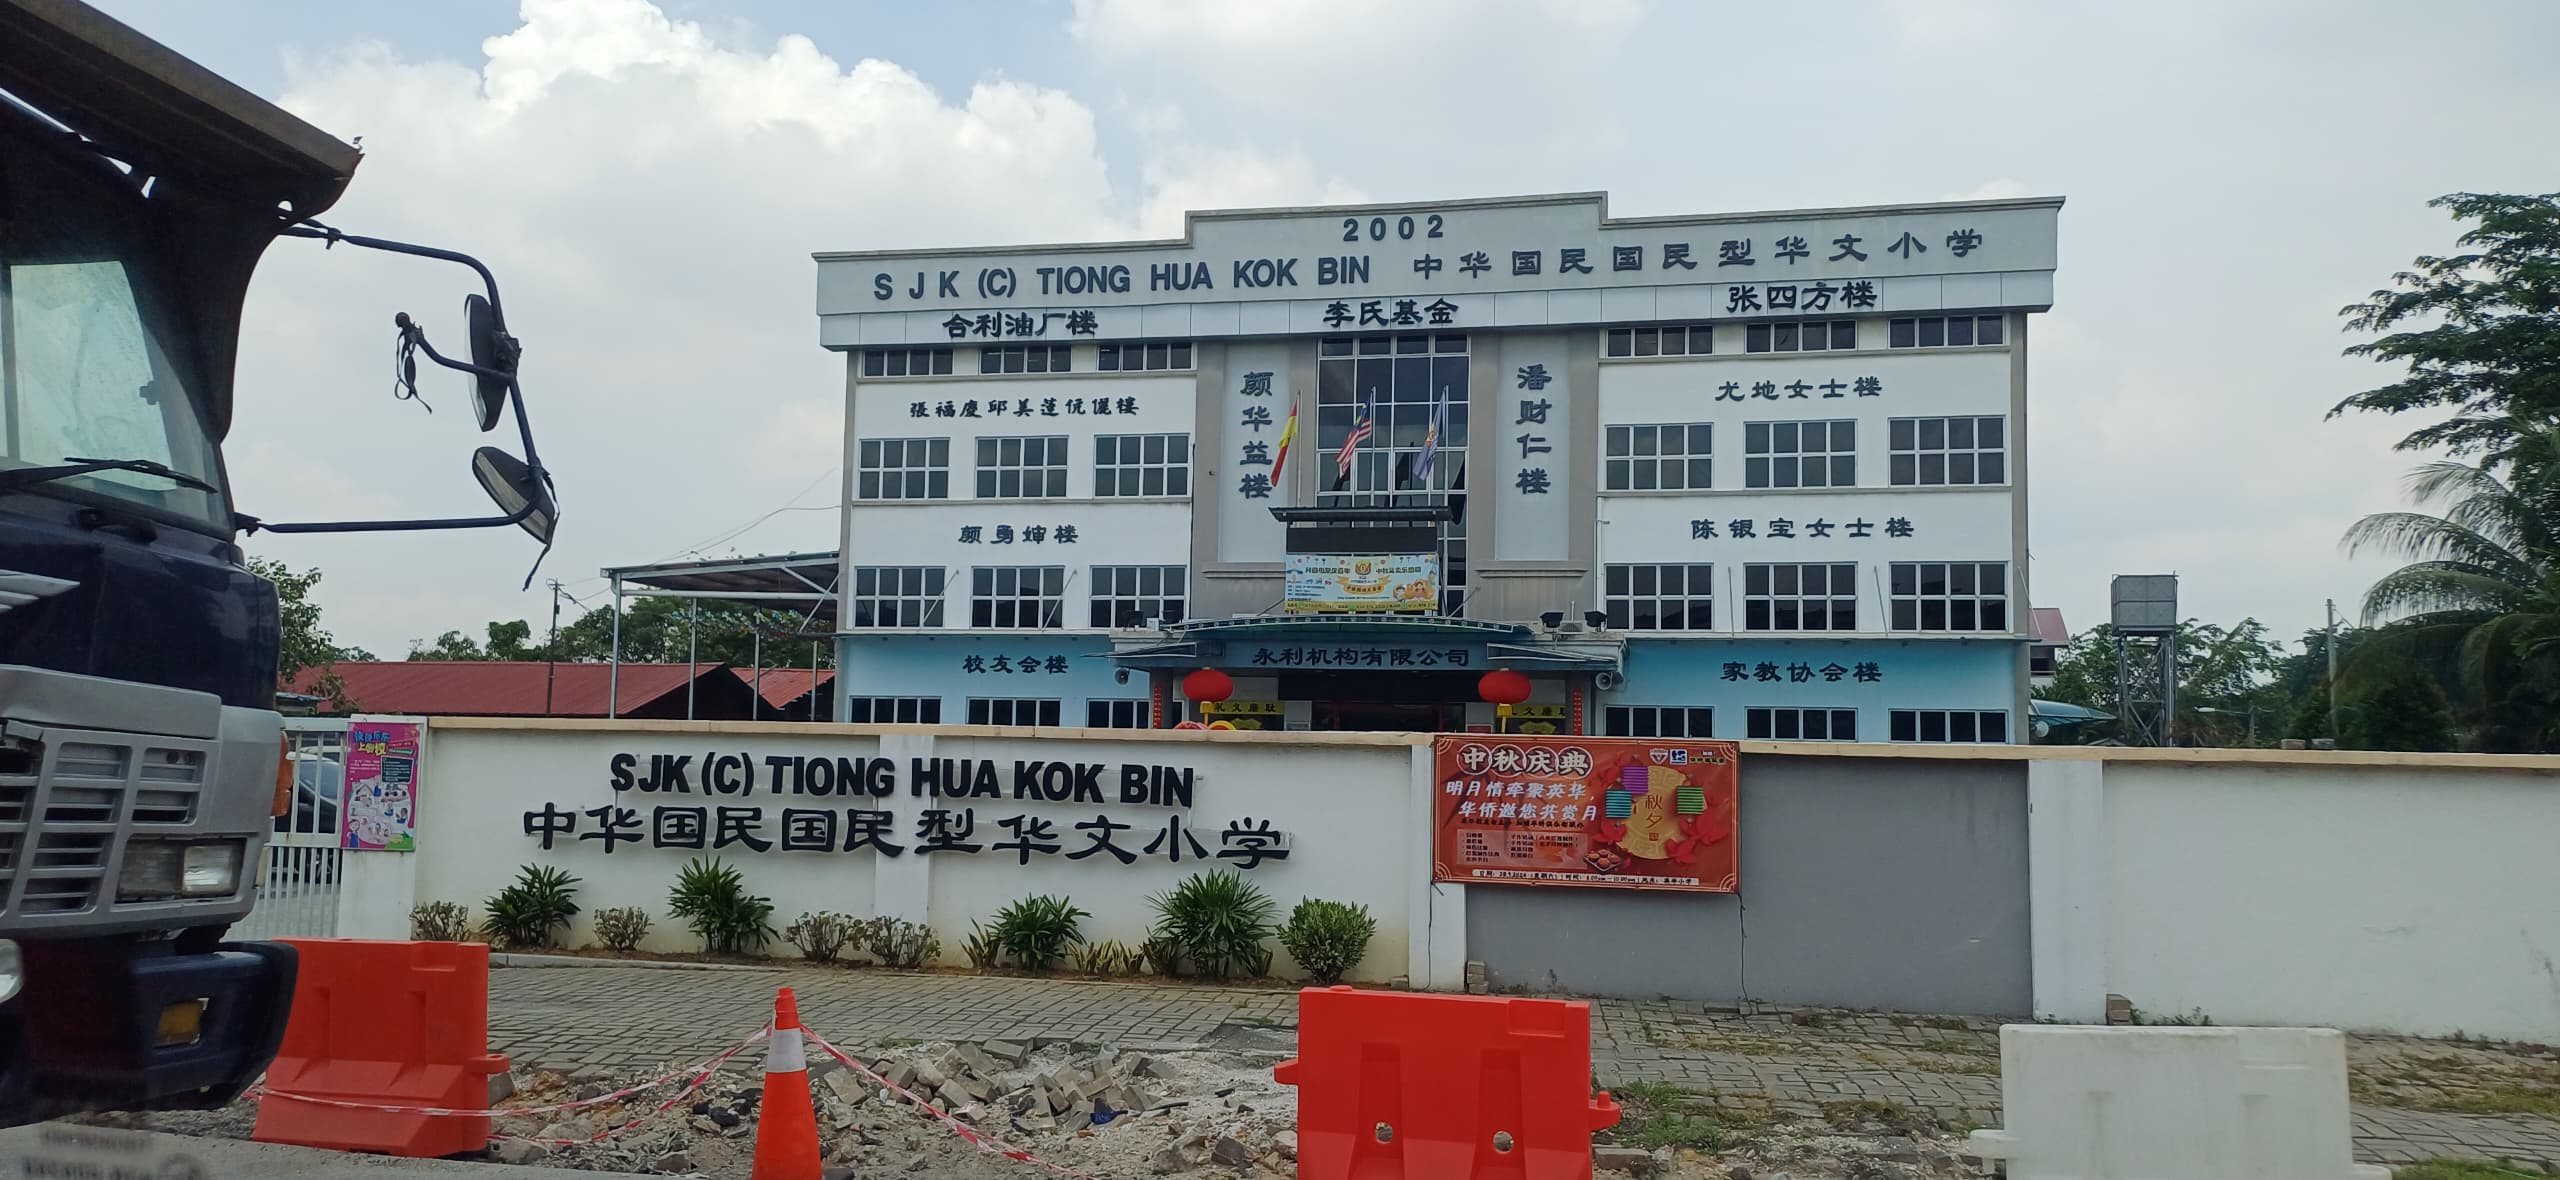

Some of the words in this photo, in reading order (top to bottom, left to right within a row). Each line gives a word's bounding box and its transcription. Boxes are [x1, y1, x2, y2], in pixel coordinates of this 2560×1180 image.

[977, 267, 1017, 300] (C)
[1035, 264, 1131, 295] TIONG
[1150, 261, 1214, 292] HUA
[1233, 258, 1299, 289] KOK
[1317, 255, 1371, 286] BIN
[1727, 280, 1878, 314] 张四方楼
[942, 310, 1098, 339] 合利油厂楼
[1322, 298, 1460, 328] 李氏基金
[1715, 375, 1883, 402] 尤地女士楼
[1238, 371, 1273, 500] 颜华益楼
[1515, 363, 1553, 495] 潘财仁楼
[1690, 516, 1915, 540] 陈银宝女士楼
[962, 653, 1069, 675] 校友会楼
[1252, 647, 1470, 667] 永利机构有限公司
[1719, 660, 1883, 683] 家教协会楼
[1460, 746, 1590, 777] 中秋庆典
[610, 753, 693, 793] SJK
[701, 752, 755, 797] (C)
[764, 755, 895, 798] TIONG
[910, 757, 1002, 799] HUA
[1013, 760, 1106, 804] KOK
[1119, 763, 1194, 808] BIN
[1458, 801, 1597, 822] 华侨邀您共赏月
[1644, 794, 1663, 829] 秋夕
[523, 802, 1291, 870] 中华国民国民型华文小学
